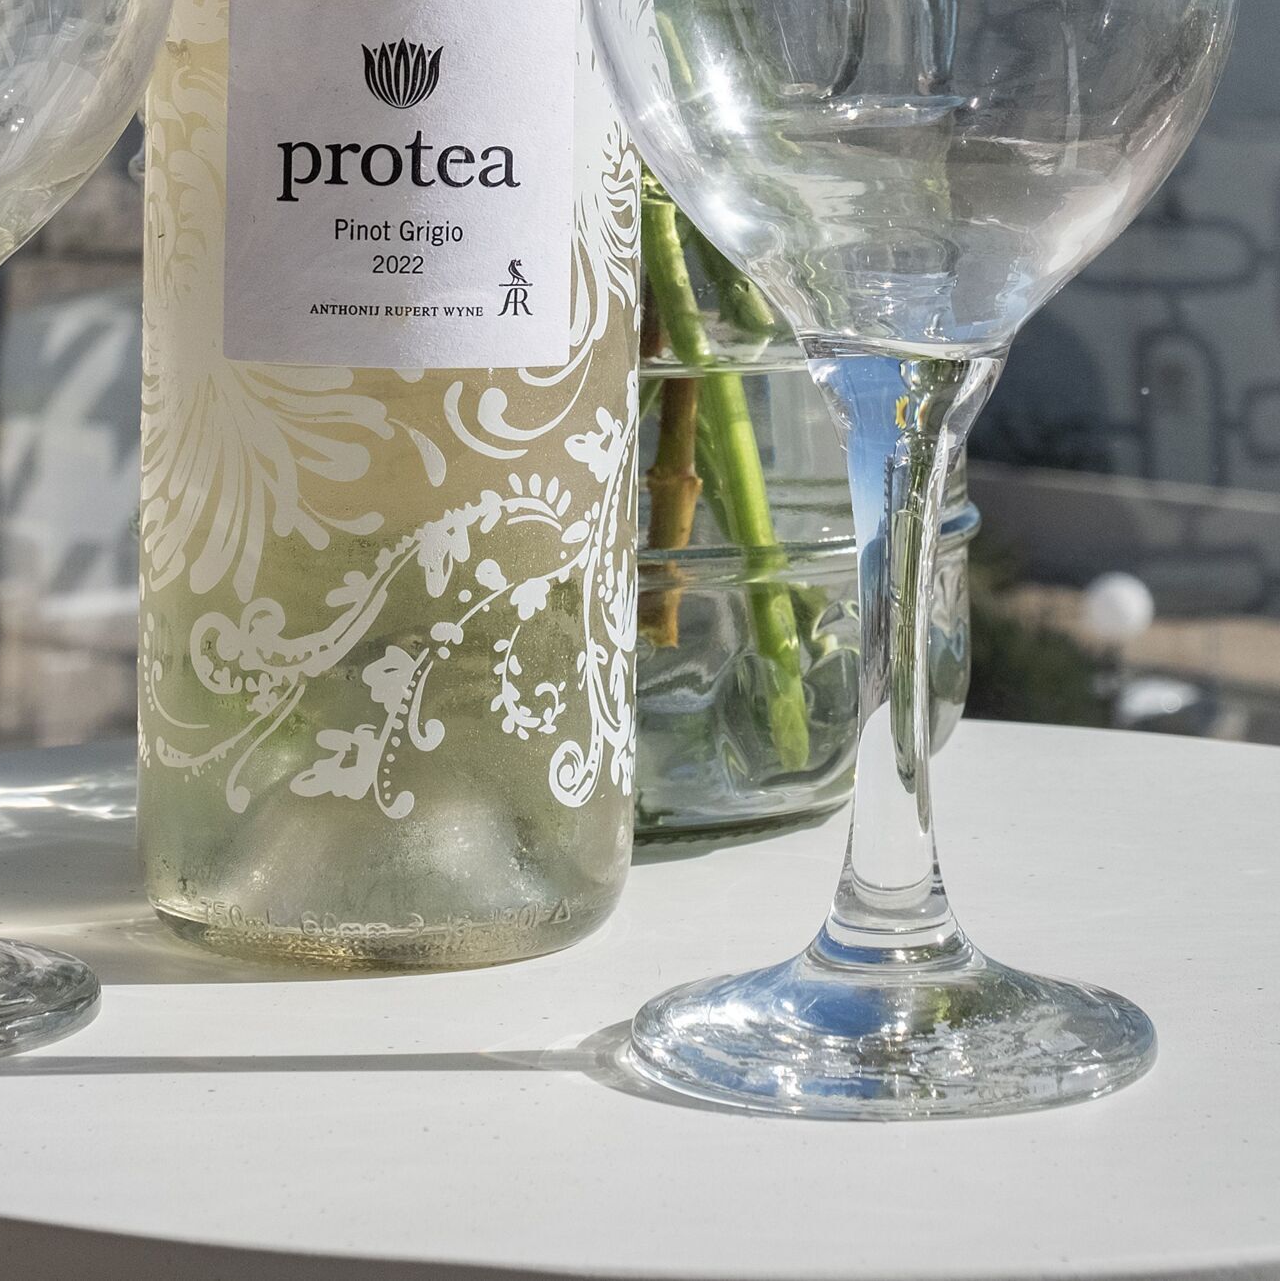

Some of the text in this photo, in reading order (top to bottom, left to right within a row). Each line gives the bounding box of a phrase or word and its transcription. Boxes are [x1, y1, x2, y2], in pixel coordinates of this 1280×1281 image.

[276, 130, 521, 202] protea
[334, 218, 464, 246] Pinot Grigio
[372, 255, 424, 274] 2022
[310, 303, 484, 317] ANTHONIJ RUPERT WYNE
